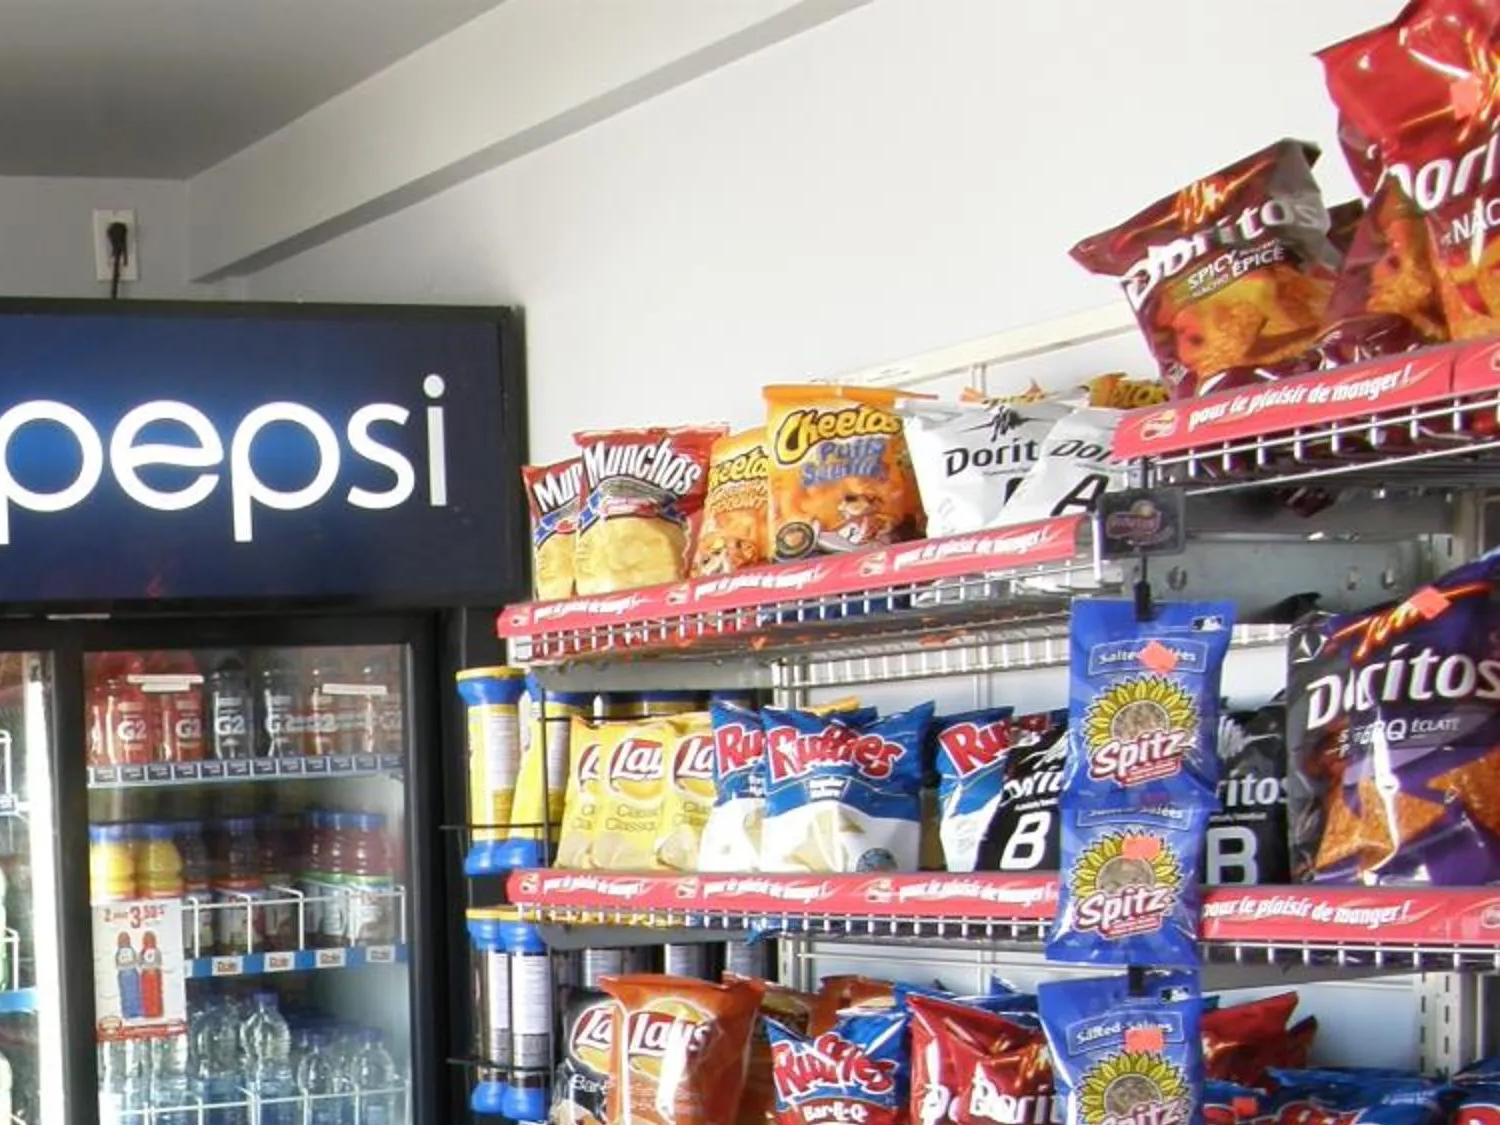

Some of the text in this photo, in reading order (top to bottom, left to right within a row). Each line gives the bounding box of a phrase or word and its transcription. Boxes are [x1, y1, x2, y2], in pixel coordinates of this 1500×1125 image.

[1187, 249, 1237, 288] SPICY
[1188, 404, 1228, 432] pour
[1231, 397, 1249, 414] le
[1247, 383, 1307, 415] plaisir
[1308, 382, 1328, 404] de
[774, 405, 901, 466] Cheetos
[583, 438, 702, 495] Munchos
[117, 718, 148, 742] G2
[766, 718, 908, 785] Ruffles
[1090, 729, 1190, 780] Spitz
[1000, 811, 1051, 870] B
[1207, 826, 1259, 885] B
[1077, 883, 1171, 935] Spitz
[1240, 896, 1257, 916] le
[1256, 896, 1312, 920] plaisir
[1312, 902, 1332, 923] de
